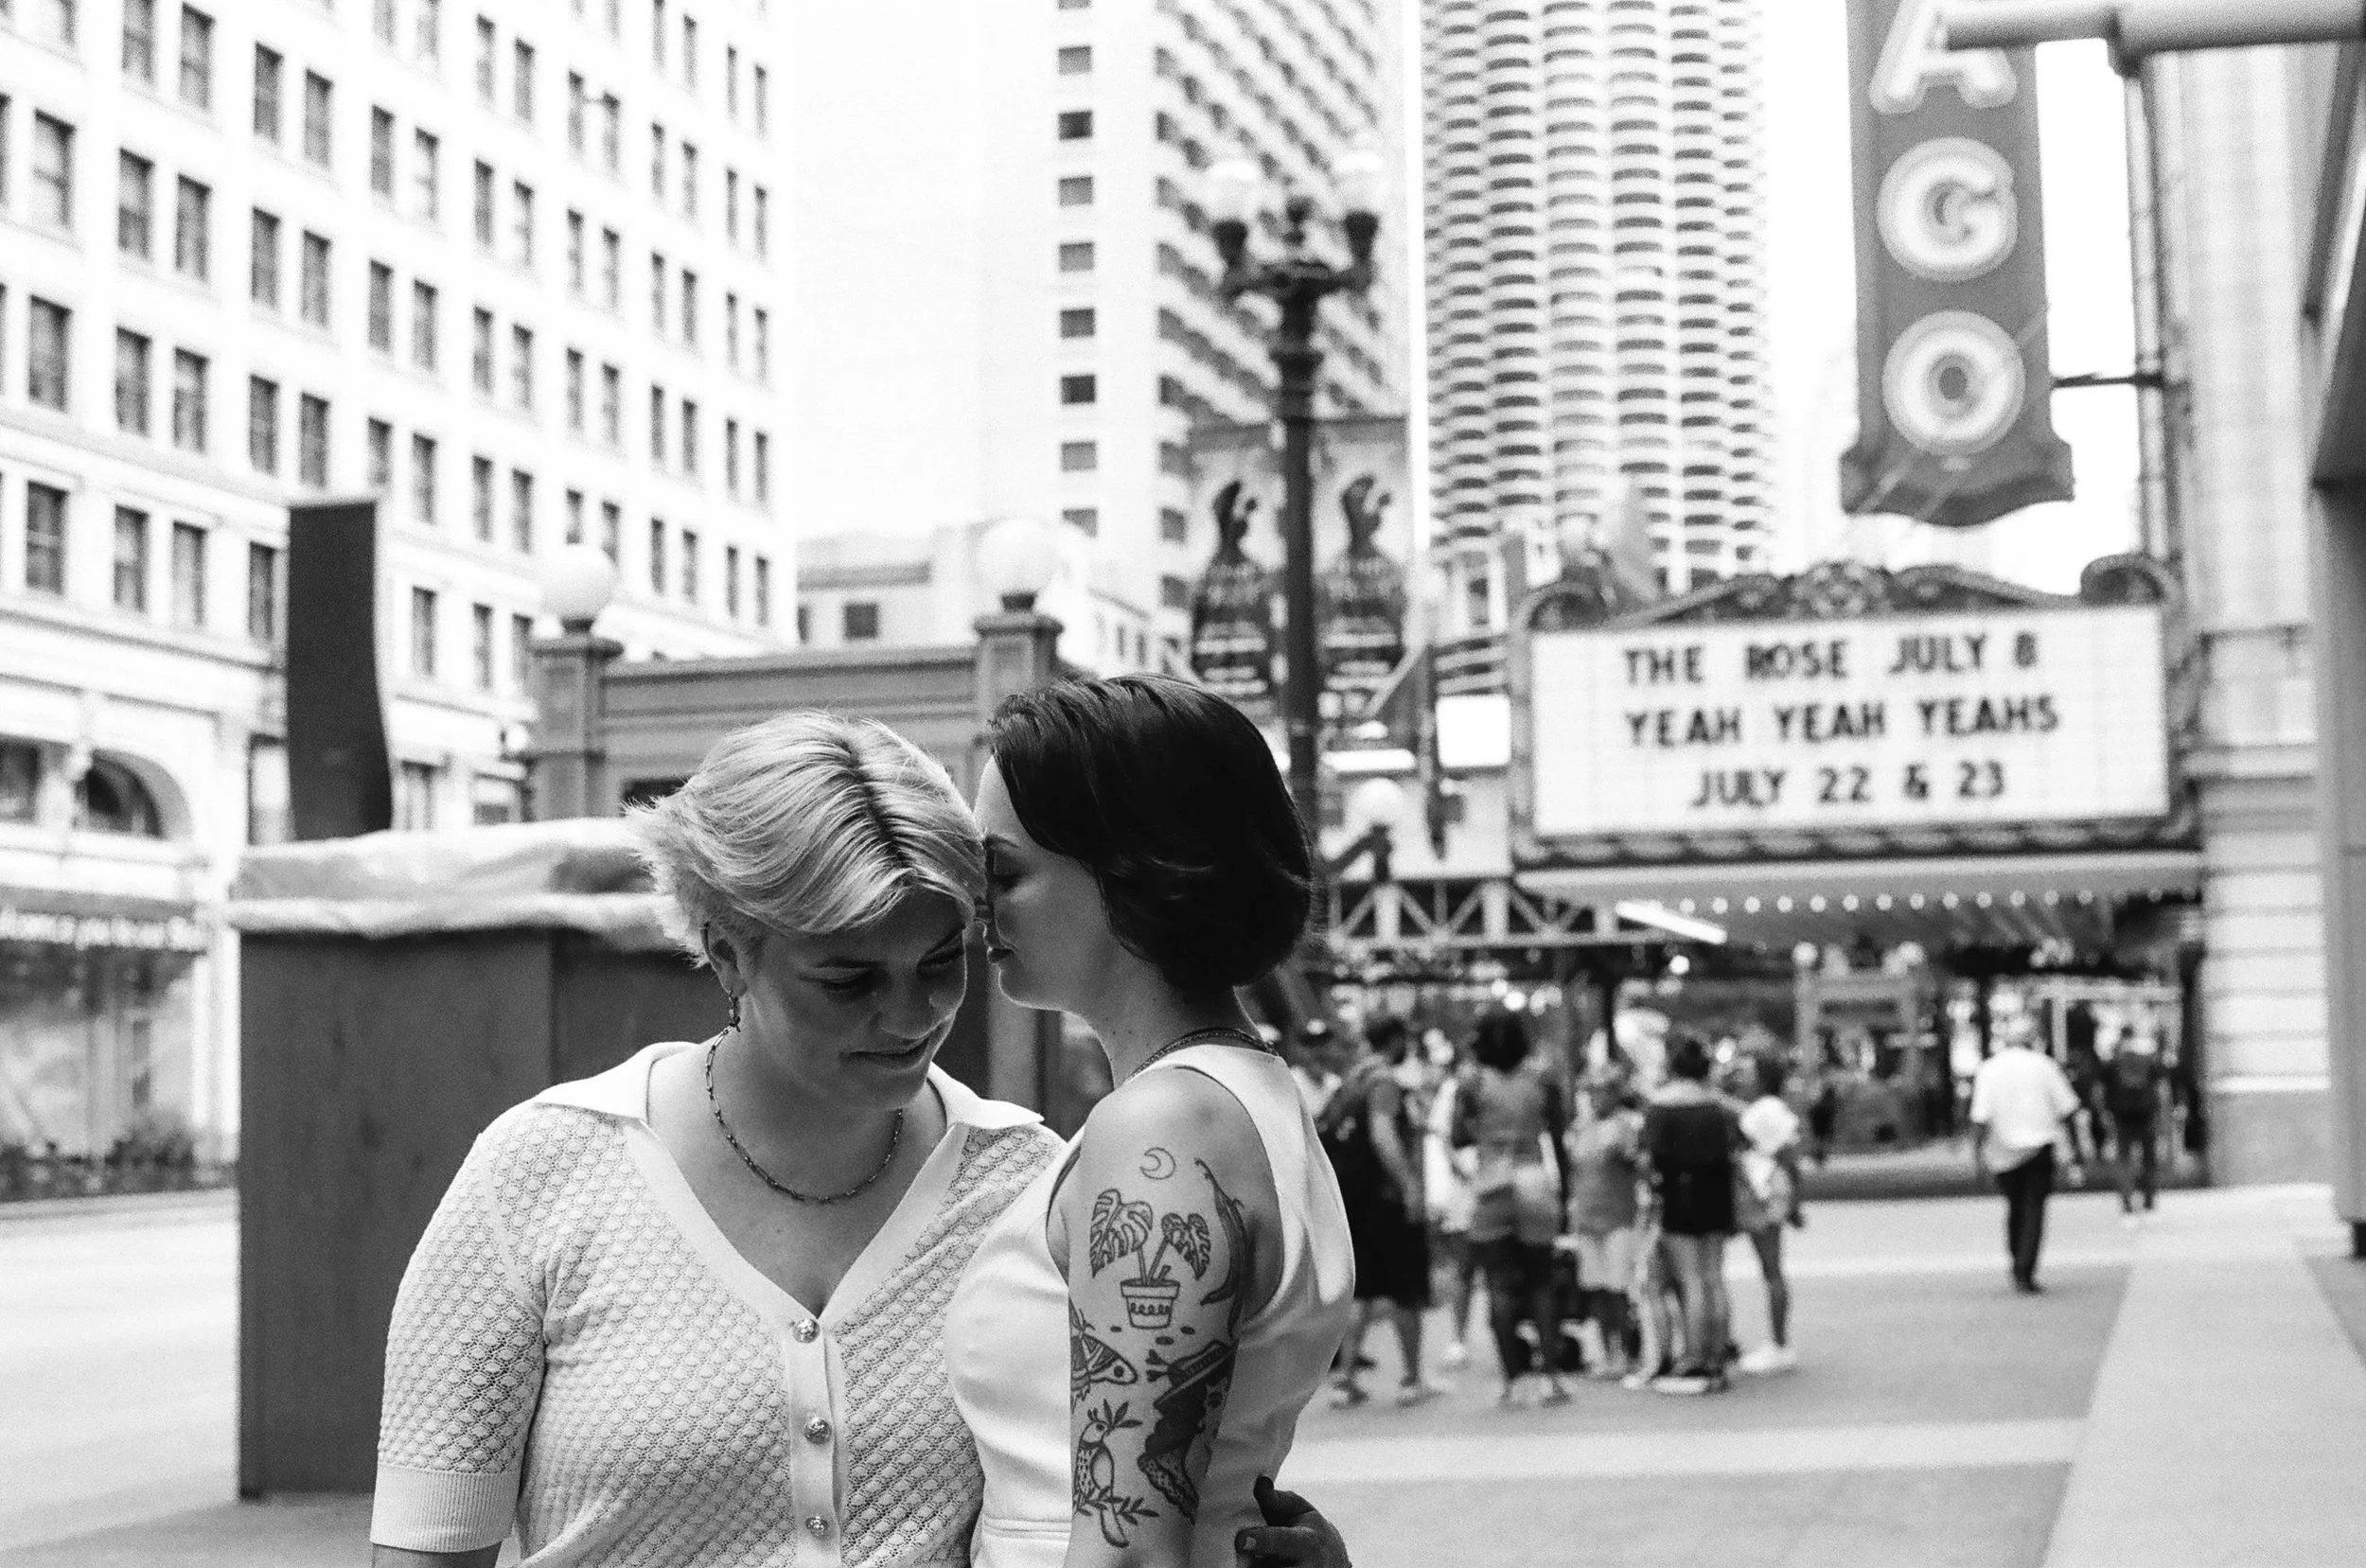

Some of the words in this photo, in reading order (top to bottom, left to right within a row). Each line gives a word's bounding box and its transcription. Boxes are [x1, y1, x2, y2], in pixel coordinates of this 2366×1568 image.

[1624, 645, 1703, 684] THE
[1744, 640, 1847, 681] ROSE
[1889, 633, 1986, 675] JULY
[1626, 708, 1740, 749] YEAH
[1774, 702, 1885, 745] YEAH
[1916, 695, 2058, 738] YEAHS
[1692, 769, 1786, 808] JULY
[1818, 766, 1870, 804] 22
[1903, 764, 1930, 802] &
[1957, 760, 2004, 800] 23
